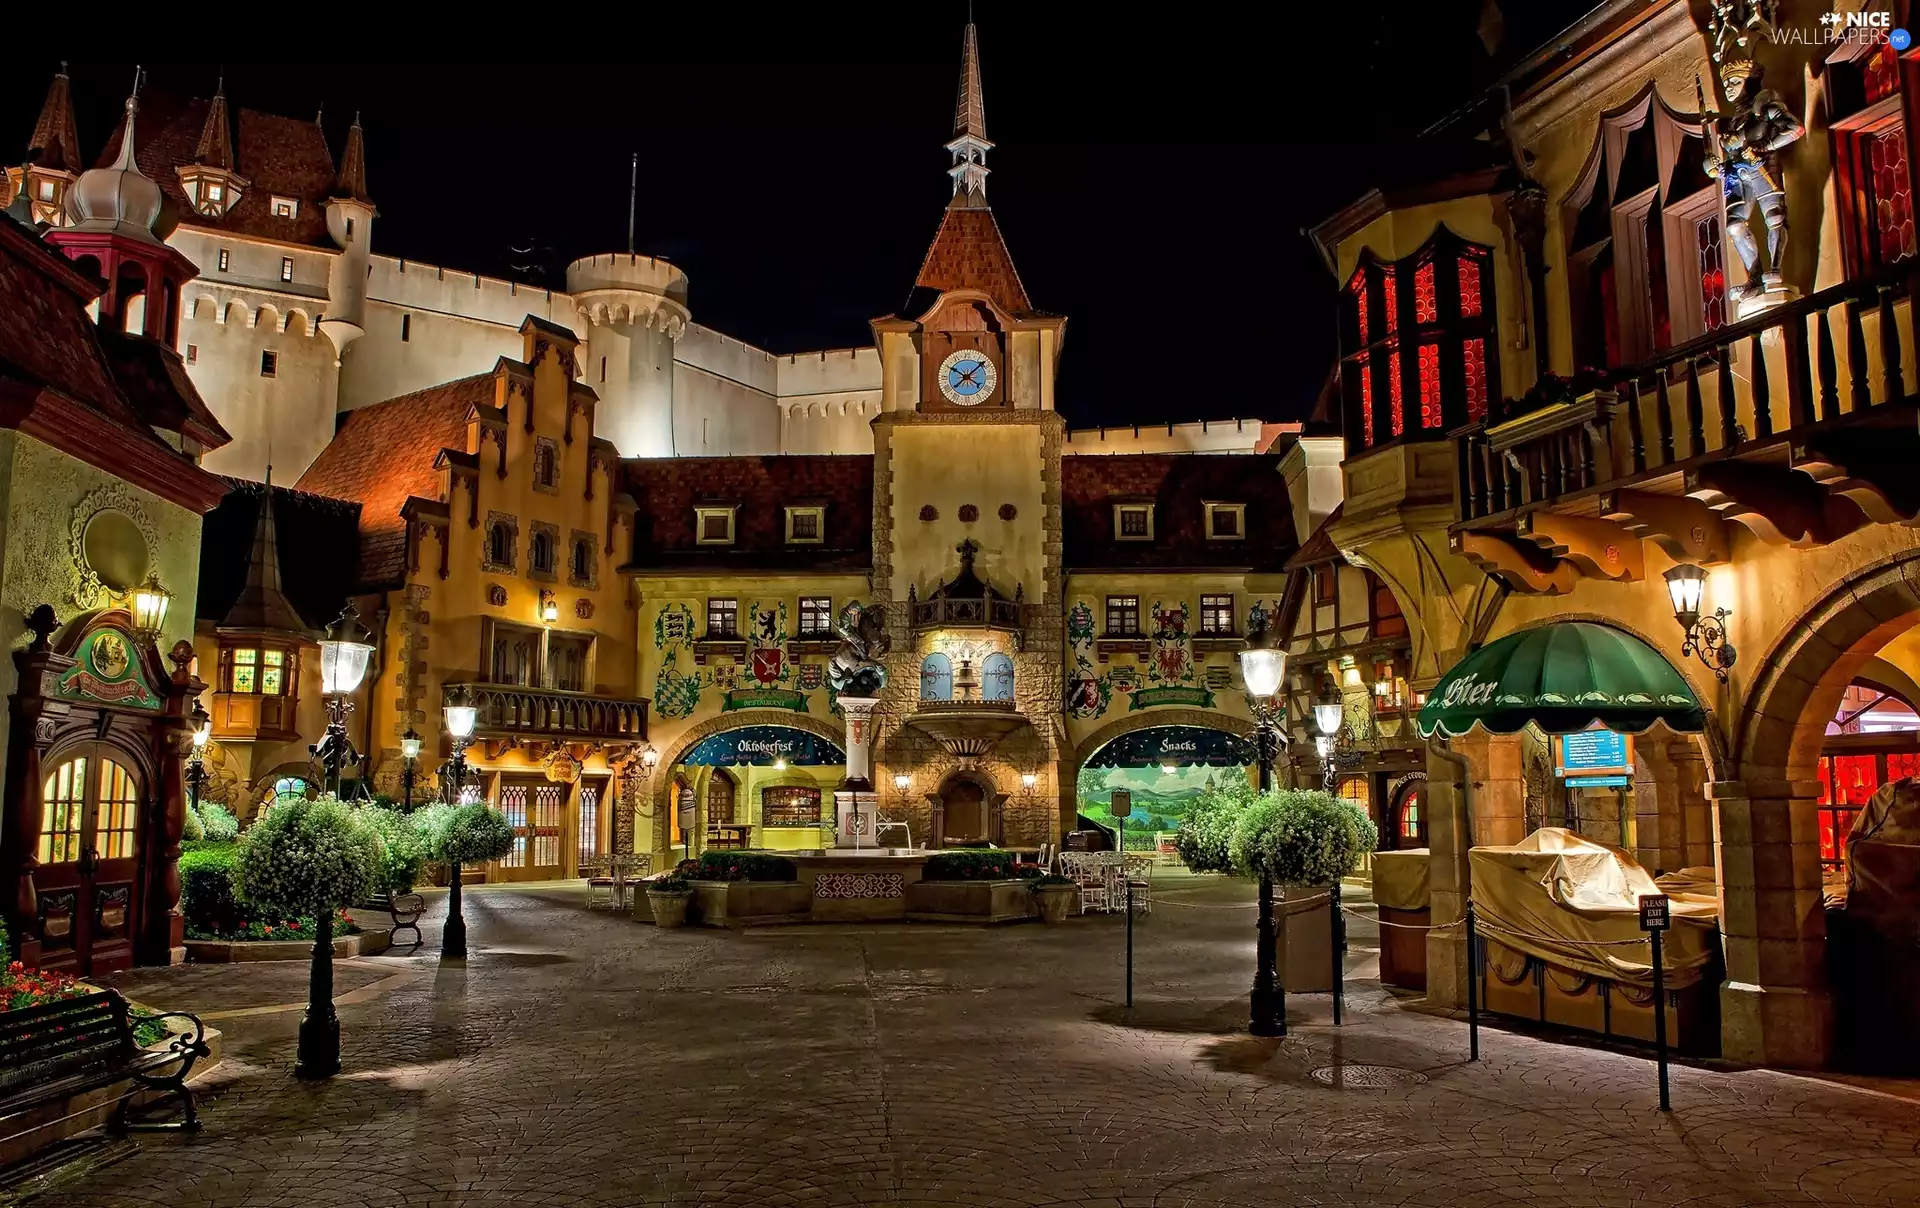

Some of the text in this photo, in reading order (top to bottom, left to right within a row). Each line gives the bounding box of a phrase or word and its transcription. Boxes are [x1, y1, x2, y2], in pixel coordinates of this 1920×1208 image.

[1441, 673, 1498, 709] Bier
[738, 740, 794, 756] Oktoberfest
[1160, 738, 1197, 753] Snacks
[1642, 900, 1667, 908] PLEASE
[1647, 909, 1663, 917] EXIT
[1646, 918, 1665, 927] HERE
